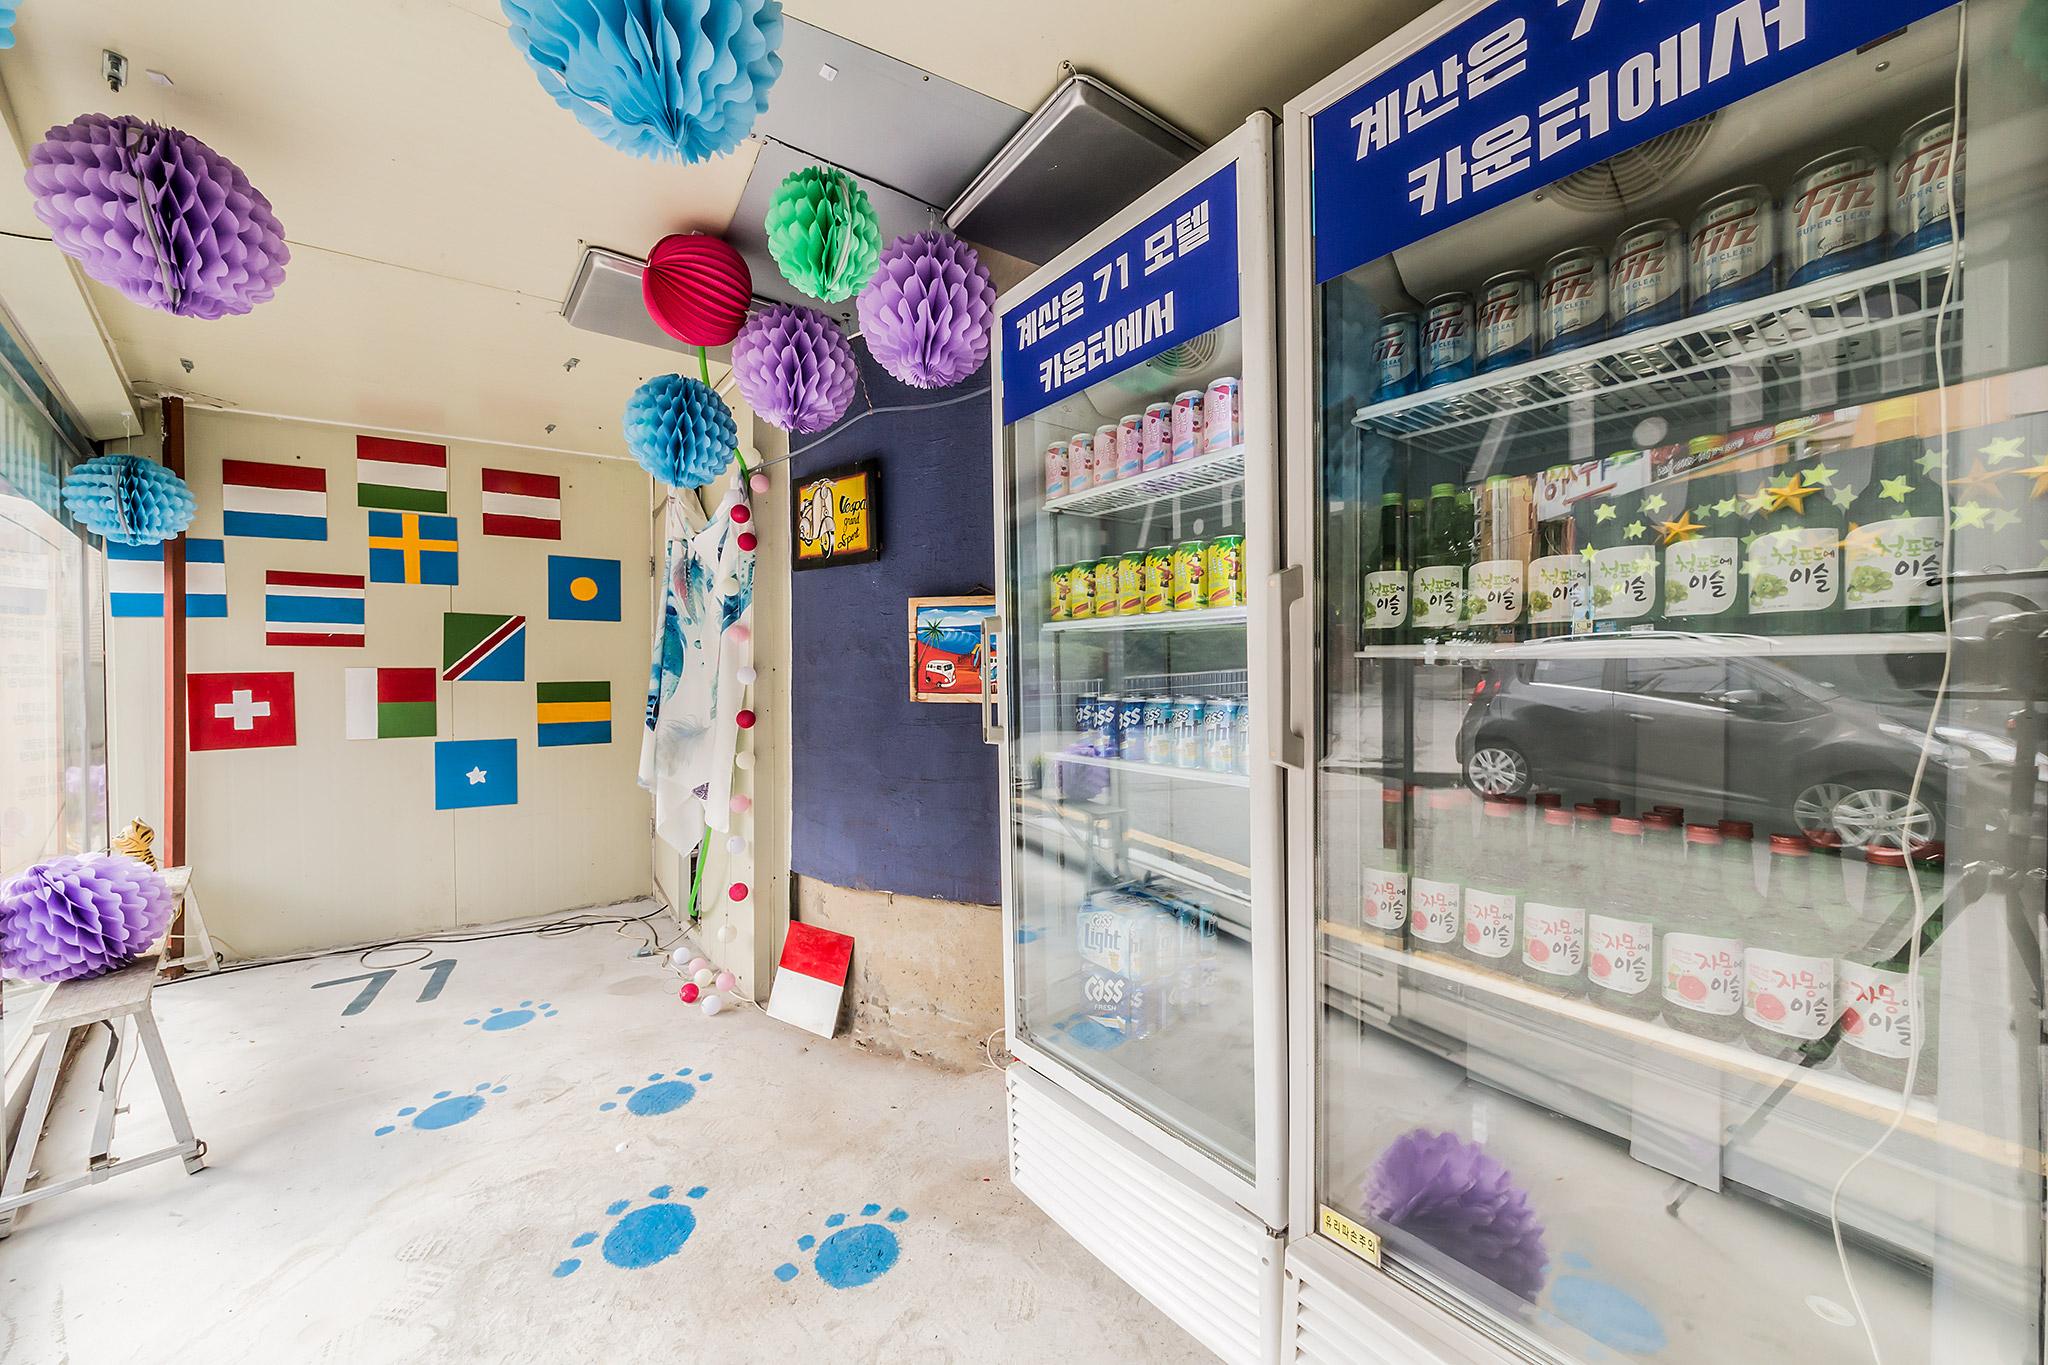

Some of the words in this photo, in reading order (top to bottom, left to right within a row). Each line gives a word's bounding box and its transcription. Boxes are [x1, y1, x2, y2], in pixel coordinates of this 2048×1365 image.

[1350, 17, 1528, 161] 계산은
[1408, 0, 1806, 215] 카운터에서
[1793, 167, 1878, 228] Fitz
[1017, 281, 1085, 351] 계산은
[1093, 252, 1129, 303] 71
[1144, 199, 1210, 277] 모텔
[1039, 291, 1175, 393] 카운터에서
[1675, 553, 1733, 574] 청포도에
[1770, 544, 1835, 567] 청포도에
[1688, 570, 1727, 598] 이슬
[1789, 562, 1831, 593] 이슬
[1377, 594, 1401, 616] 이슬
[1430, 591, 1455, 614] 이슬
[1487, 586, 1516, 611] 이슬
[1373, 881, 1406, 901] 자몽에
[1421, 892, 1458, 913] 자몽에
[1380, 899, 1404, 921] 이슬
[1430, 911, 1455, 934] 이슬
[1474, 904, 1513, 926] 자몽에
[1483, 924, 1510, 948] 이슬
[1540, 919, 1583, 942] 자몽에
[1552, 940, 1581, 965] 이슬
[1602, 932, 1650, 957] 자몽에
[1614, 956, 1648, 983] 이슬
[310, 958, 458, 1017] 71
[1710, 975, 1741, 1003] 이슬
[1772, 969, 1832, 998] 자몽에
[1790, 996, 1830, 1027] 이슬
[1325, 1215, 1376, 1255] 유리파손주의
